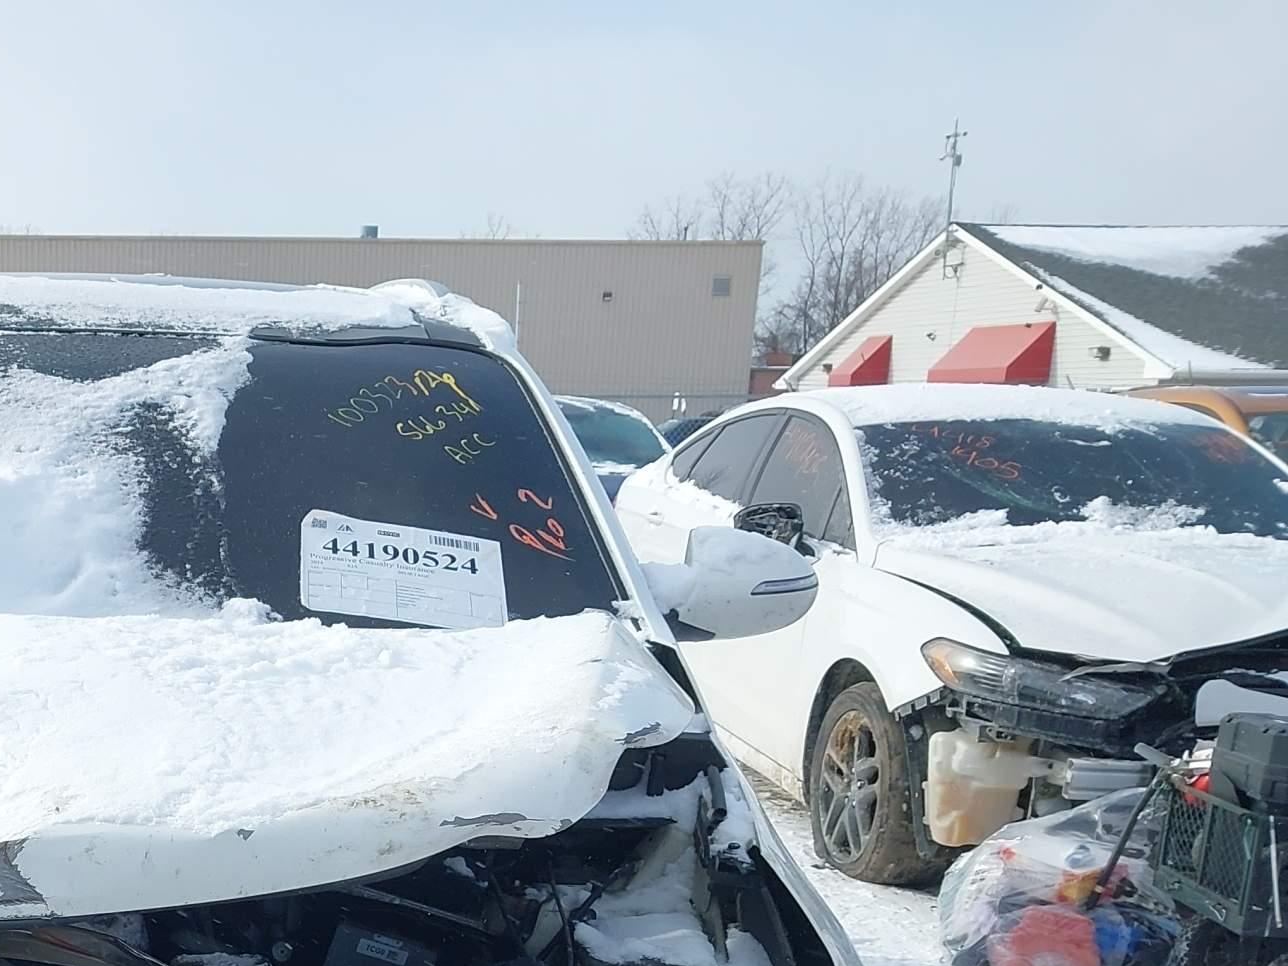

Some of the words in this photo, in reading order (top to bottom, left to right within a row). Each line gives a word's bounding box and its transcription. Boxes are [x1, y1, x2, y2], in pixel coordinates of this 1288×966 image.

[310, 552, 357, 564] Progressive
[358, 558, 394, 569] Casualty
[396, 563, 434, 574] Insurance
[322, 537, 479, 575] 44190524
